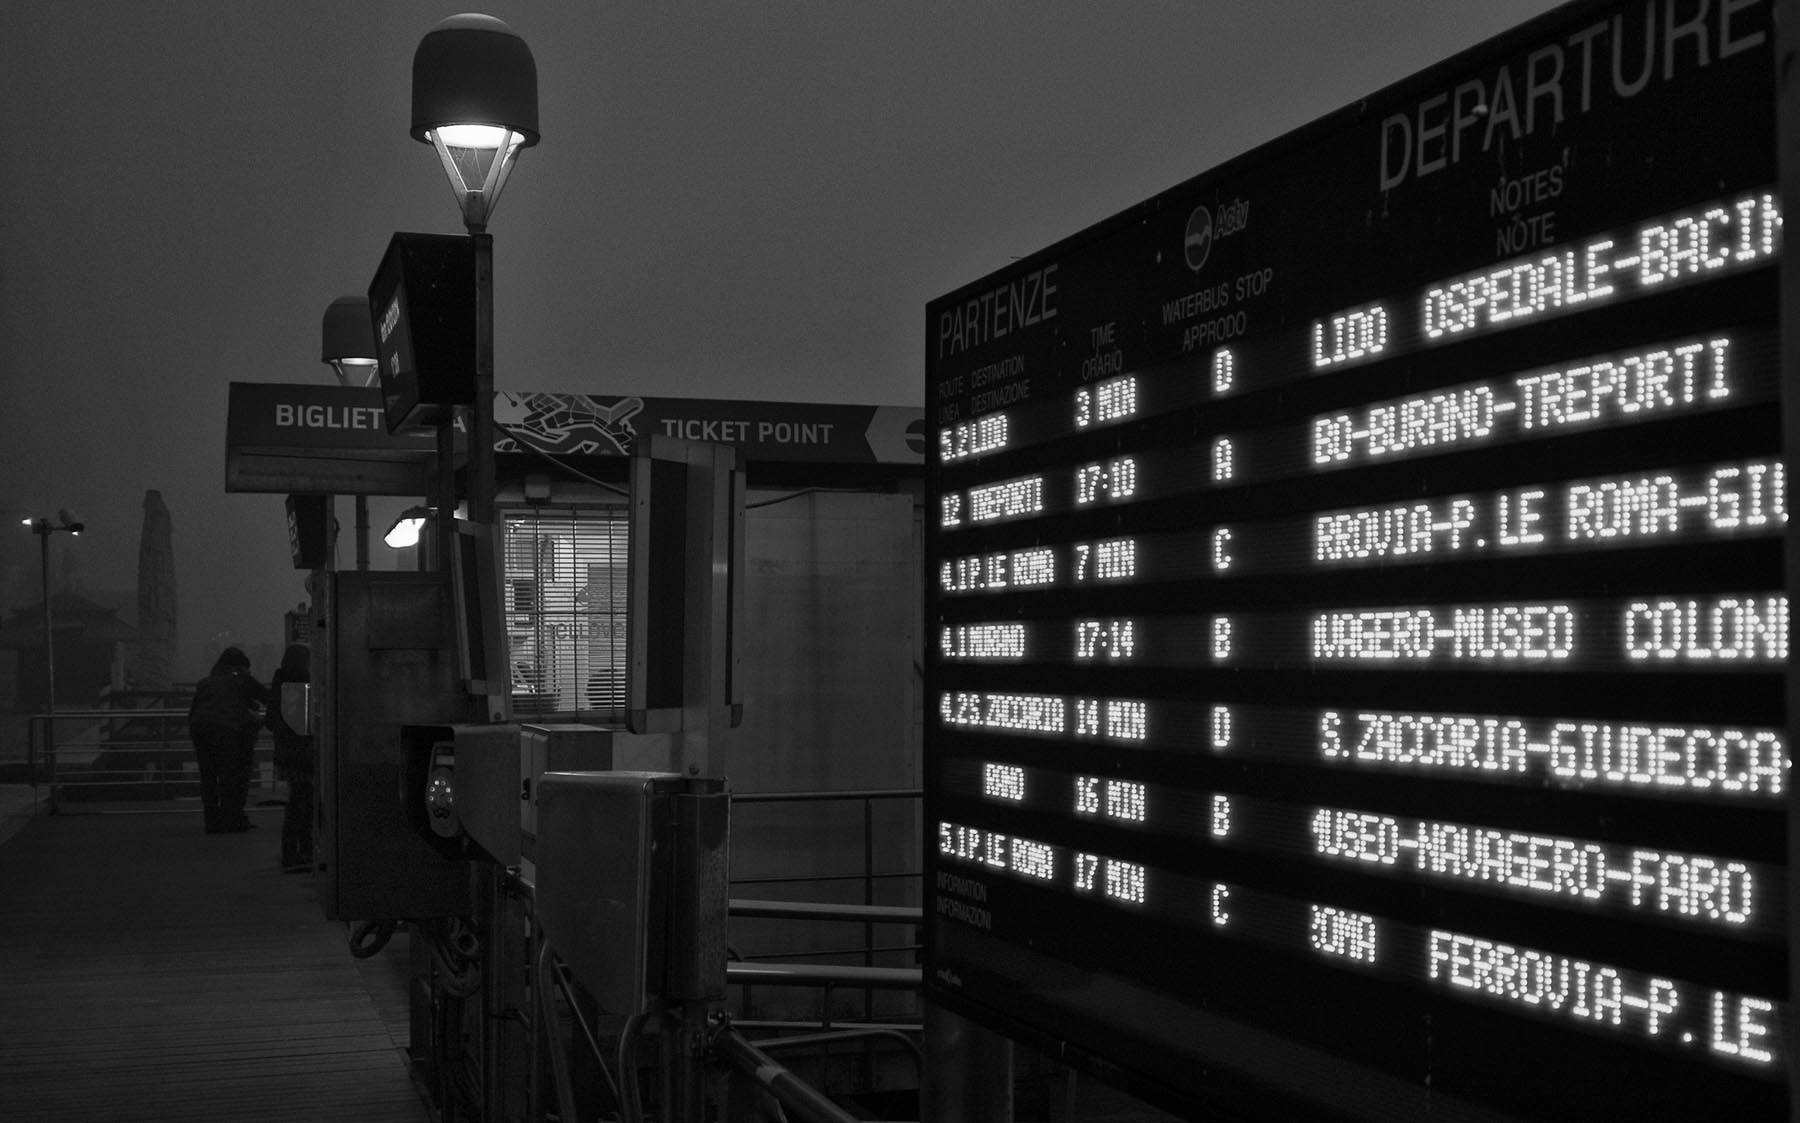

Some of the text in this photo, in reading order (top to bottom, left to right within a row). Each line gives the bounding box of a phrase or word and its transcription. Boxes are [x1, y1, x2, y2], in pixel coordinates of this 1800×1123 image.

[1490, 165, 1564, 217] NOTES
[1496, 212, 1557, 257] NOTE
[938, 264, 1059, 361] PARTENZE
[1161, 267, 1274, 326] WATERBUS STOP
[1090, 322, 1116, 349] TIME
[1182, 311, 1247, 352] APPRODO
[971, 354, 1025, 390] DESTINATION
[1076, 390, 1091, 427] 3
[1096, 377, 1136, 422] MIN
[1314, 306, 1387, 368] LIDO
[1081, 350, 1124, 381] ORARIO
[971, 379, 1031, 416] DESTINAZIONE
[660, 418, 834, 445] TICKET POINT
[941, 494, 961, 527] 12
[969, 477, 1044, 522] TREPORTI
[1077, 458, 1136, 504] 17:10
[1214, 438, 1233, 481] A
[1012, 549, 1055, 586] ROMA
[1075, 544, 1090, 581] 7
[1096, 539, 1135, 579] MIN
[1213, 528, 1232, 570] C
[1076, 620, 1135, 658] 17:14
[1213, 617, 1232, 659] B
[1076, 699, 1100, 736] 14
[1106, 700, 1146, 740] MIN
[1212, 706, 1231, 748] D
[1320, 711, 1793, 795] S.ZACCARIA-GIUDECCA
[1076, 776, 1099, 814] 16
[1107, 780, 1145, 822] MIN
[1212, 795, 1231, 837] B
[1011, 838, 1054, 880] ROMA
[1075, 852, 1099, 890] 17
[1106, 859, 1145, 904] MIN
[1212, 883, 1230, 925] C
